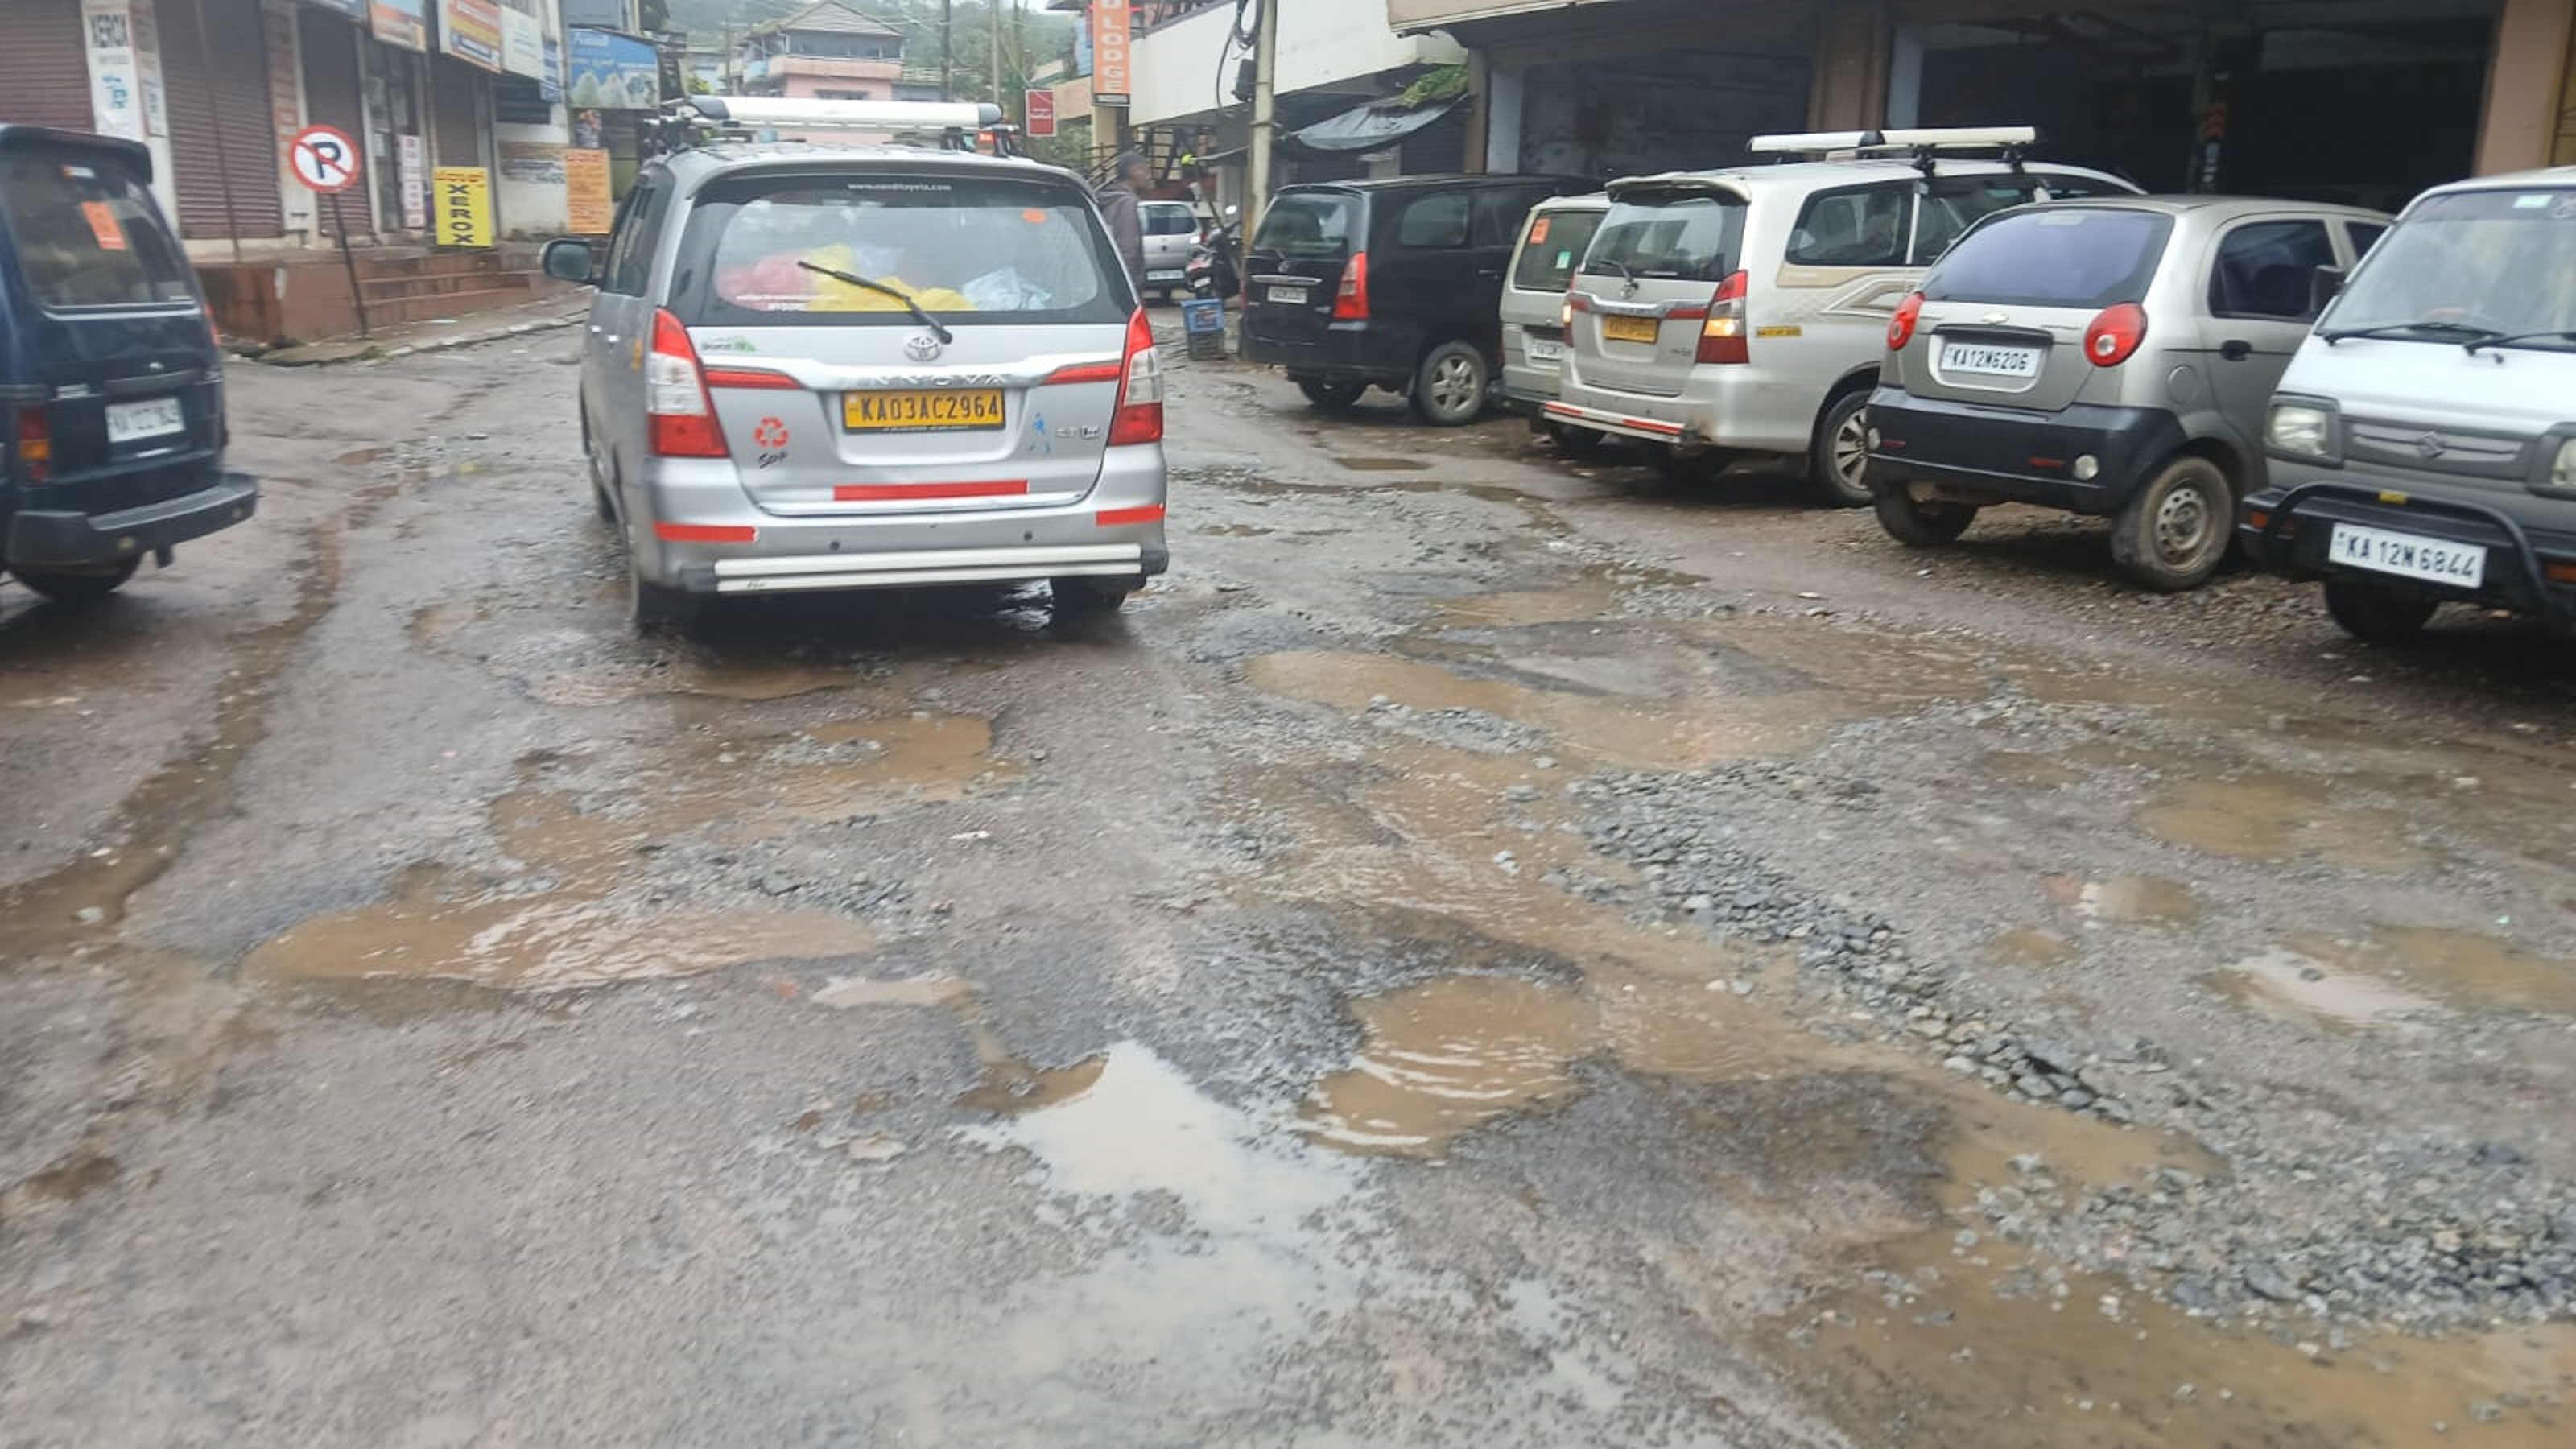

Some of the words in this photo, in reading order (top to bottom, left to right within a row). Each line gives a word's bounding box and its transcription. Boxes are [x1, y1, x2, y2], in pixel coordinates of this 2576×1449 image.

[1100, 17, 1124, 93] LODGE
[447, 184, 474, 244] XEROX
[861, 395, 999, 421] KA03AC2964
